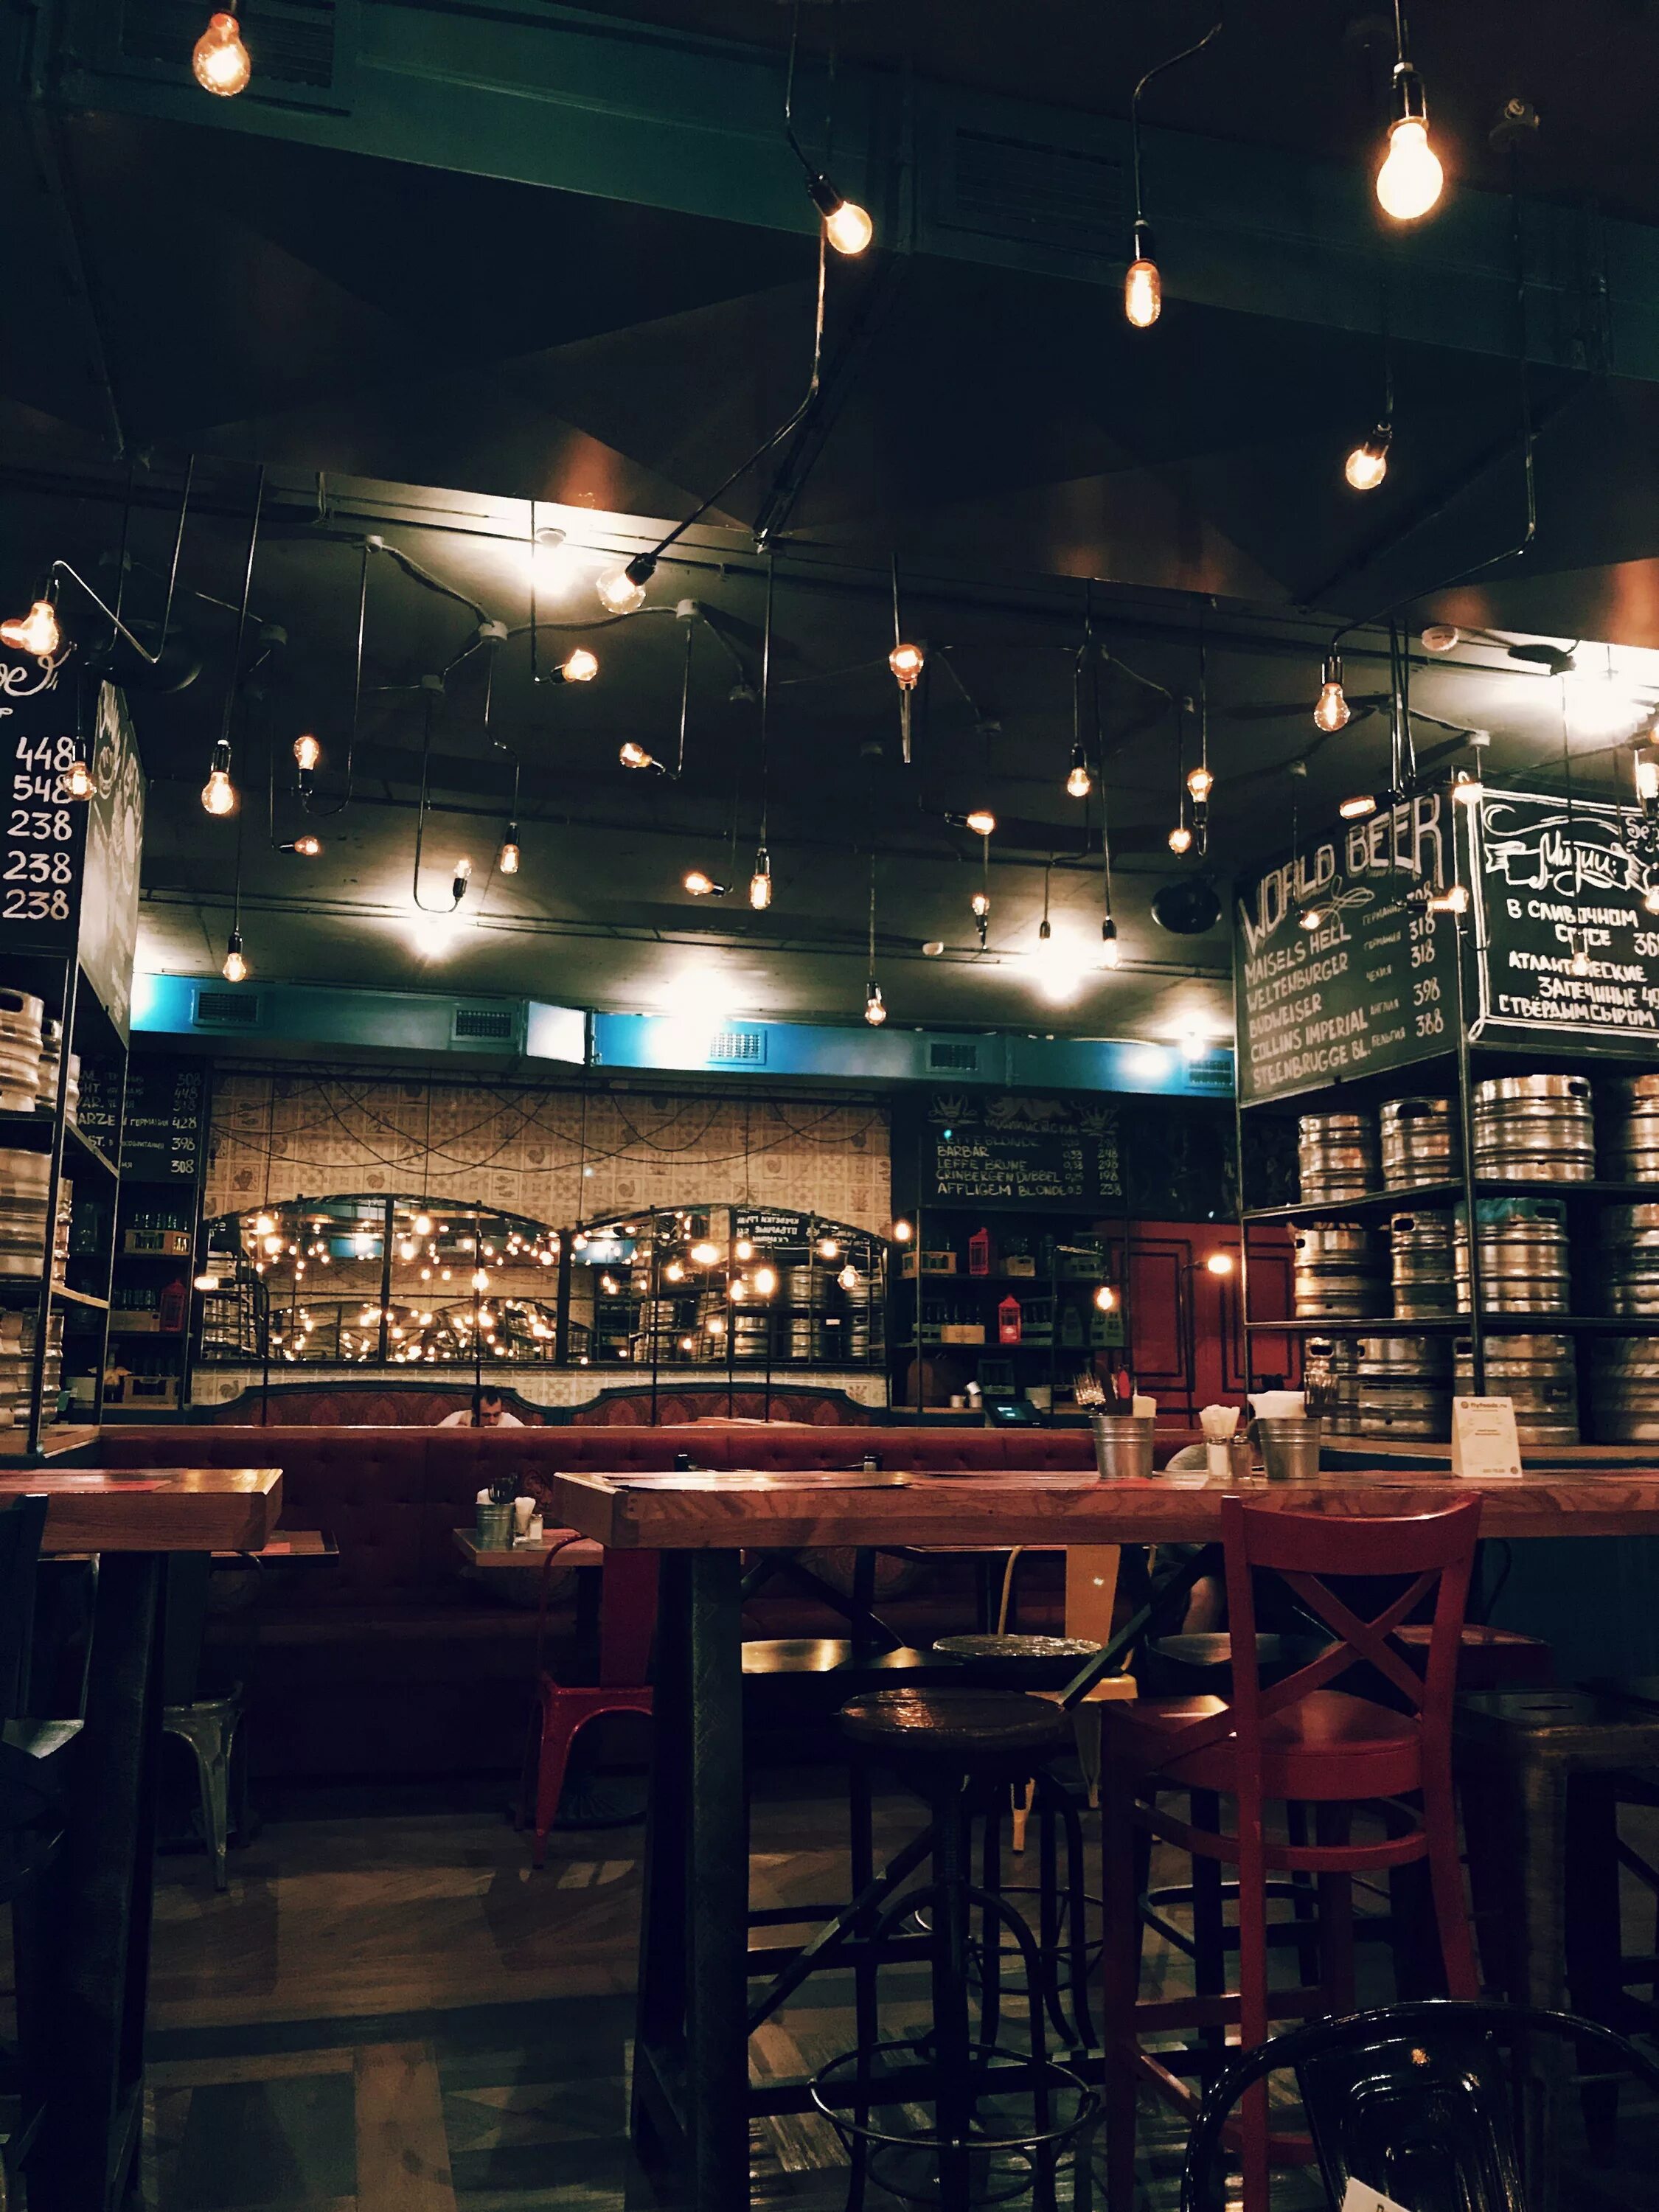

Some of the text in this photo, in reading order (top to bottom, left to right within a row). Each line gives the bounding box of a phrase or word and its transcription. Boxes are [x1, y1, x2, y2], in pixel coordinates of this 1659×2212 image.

[15, 736, 74, 772] 448
[7, 810, 72, 841] 238
[2, 850, 72, 884] 238
[1239, 793, 1444, 956] WORLD BEER
[2, 888, 69, 920] 238
[1506, 898, 1638, 928] В СЛИВОЧНОМ
[1245, 942, 1307, 988] MAISELS
[1310, 923, 1352, 955] HELL
[1633, 932, 1659, 957] 36
[1246, 952, 1349, 1012] WELTENBURGER
[1409, 911, 1436, 941] 318
[1509, 950, 1648, 982] АТЛАНТЧЕСКИЕ
[1249, 993, 1322, 1039] BUDWEISER
[1411, 939, 1436, 968] 318
[1251, 1029, 1302, 1063] COLLINS
[1305, 1007, 1369, 1046] IMPERIAL
[1413, 977, 1440, 1006] 398
[1499, 994, 1655, 1027] С ТВЁРДЫМ СЫРОМ
[1253, 1043, 1348, 1089] STEENBRUGGE
[1352, 1039, 1371, 1060] BL.
[1416, 1008, 1444, 1037] 388
[174, 1088, 198, 1099] 448
[177, 1074, 201, 1086] 308
[77, 1113, 115, 1126] ARZE
[172, 1116, 197, 1130] 428
[171, 1137, 195, 1150] 398
[937, 1146, 990, 1157] BARBAR
[170, 1159, 195, 1174] 308
[938, 1158, 979, 1169] LEFFE
[985, 1160, 1027, 1171] BRUNE
[1016, 1171, 1062, 1184] DUBBEL
[937, 1183, 1012, 1196] AFFLIGEM
[1018, 1184, 1067, 1197] BLONDE
[1099, 1183, 1122, 1197] 238
